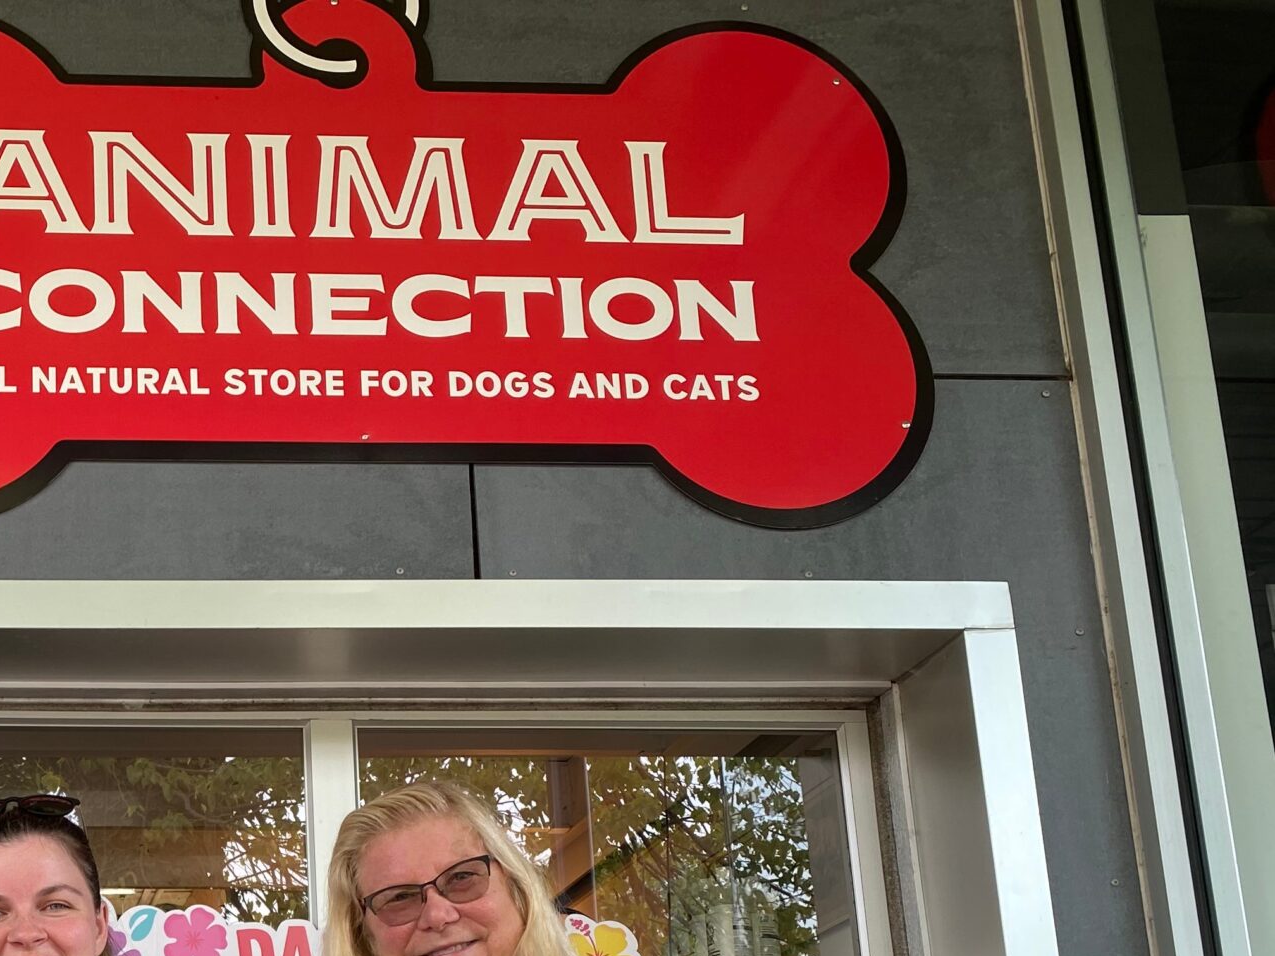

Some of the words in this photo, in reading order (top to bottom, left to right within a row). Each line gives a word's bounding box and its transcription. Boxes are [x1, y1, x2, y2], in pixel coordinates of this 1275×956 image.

[32, 367, 209, 394] NATURAL
[225, 369, 344, 396] STORE
[361, 370, 433, 396] FOR
[449, 371, 554, 398] DOGS
[569, 373, 649, 399] AND
[664, 374, 759, 401] CATS
